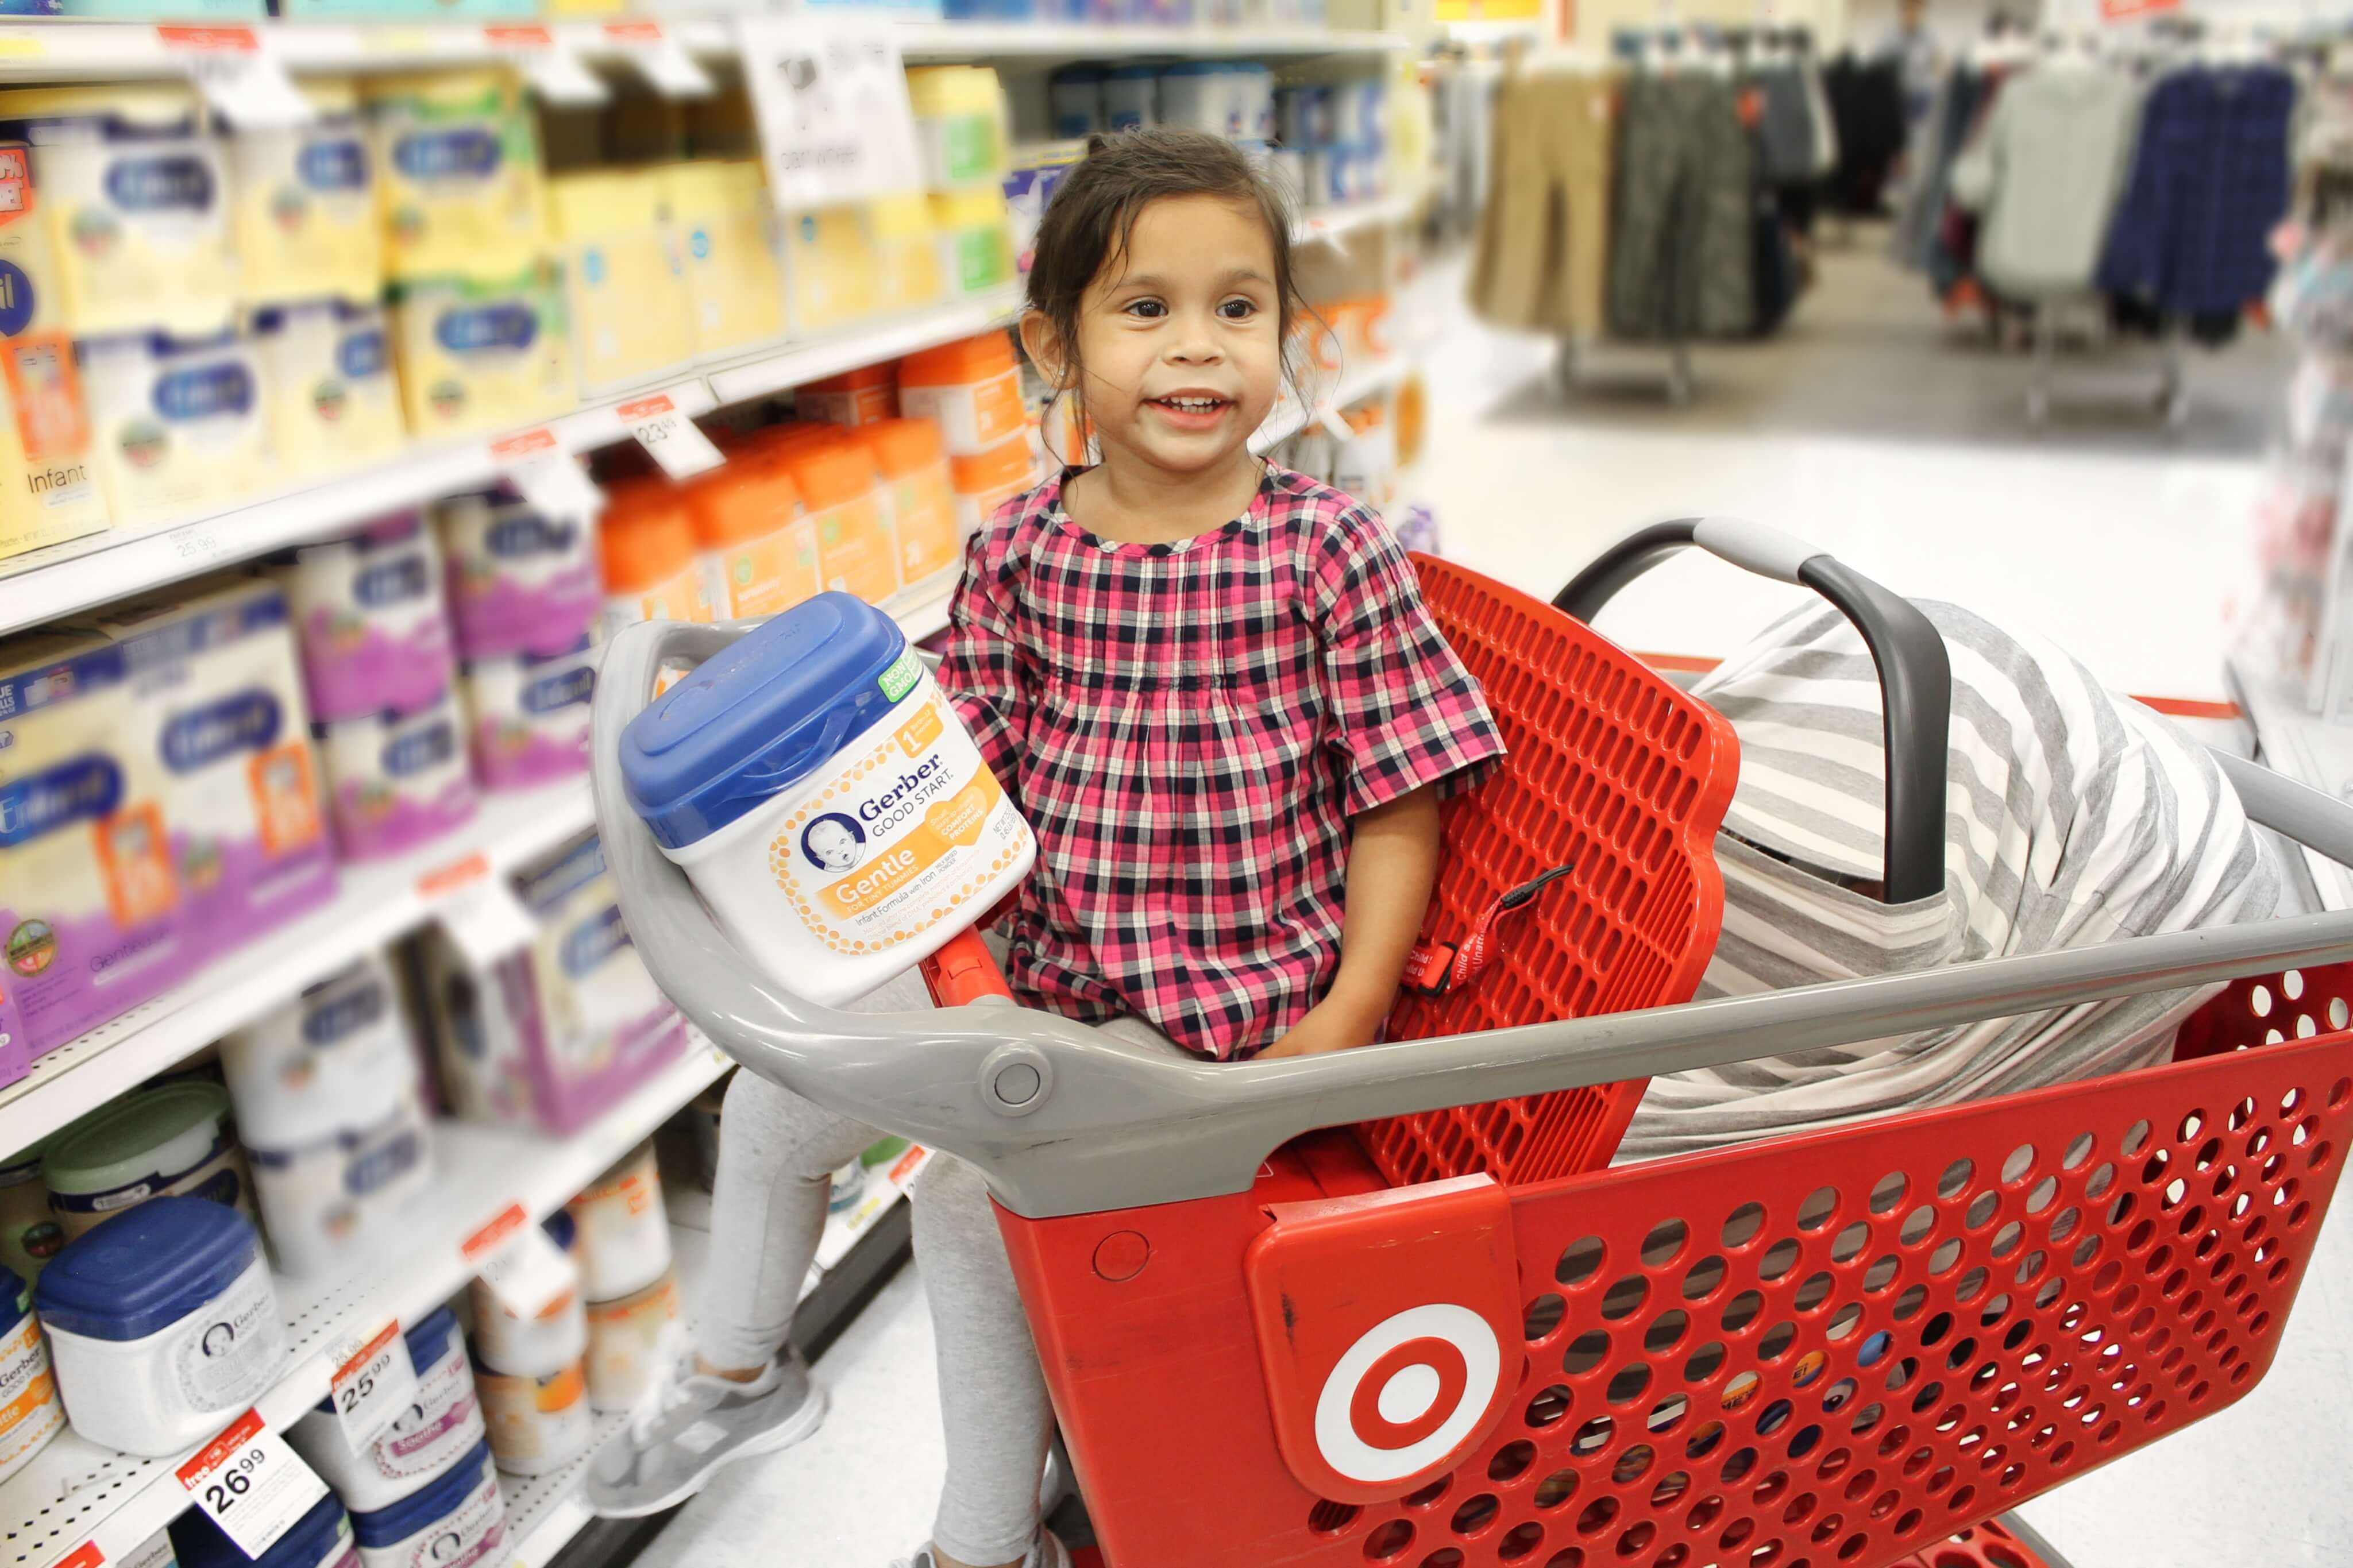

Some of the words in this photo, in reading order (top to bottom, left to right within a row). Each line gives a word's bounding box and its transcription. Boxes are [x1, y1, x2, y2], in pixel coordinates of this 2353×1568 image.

[28, 465, 87, 494] Infant
[882, 663, 906, 687] NON
[889, 673, 913, 697] GMO
[902, 731, 922, 752] 1
[859, 754, 939, 821] Gerber
[873, 802, 915, 837] GOOD
[942, 804, 975, 836] COMFORT
[949, 808, 984, 840] PROTEINS
[836, 850, 915, 903] Gentle
[847, 900, 865, 912] FOR
[864, 889, 884, 903] TINY
[883, 864, 919, 891] TUMMIES
[855, 910, 878, 926] Infant
[877, 892, 909, 916] Formula
[909, 883, 922, 895] with
[920, 871, 937, 885] Iron
[1456, 953, 1469, 982] Child
[0, 1347, 40, 1387] Gerber
[184, 1465, 211, 1489] free
